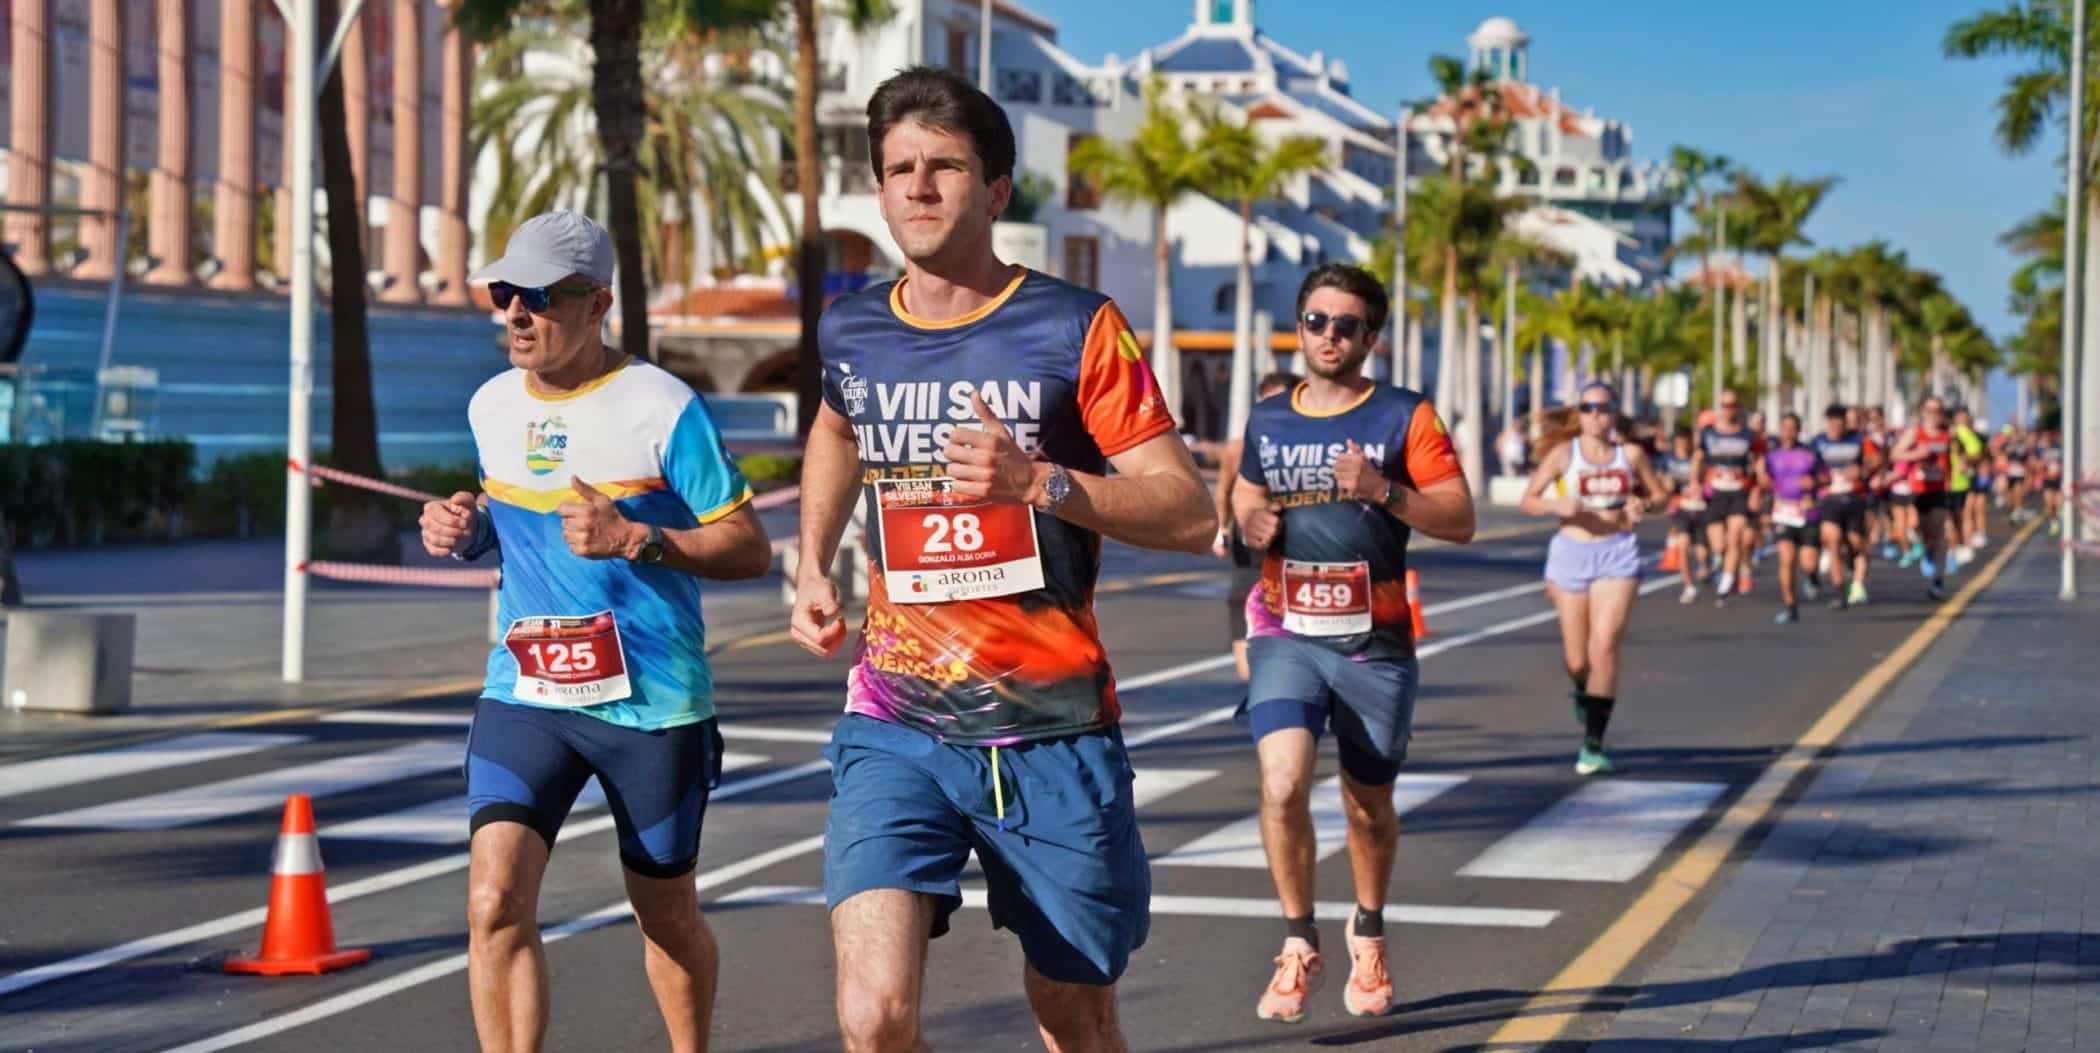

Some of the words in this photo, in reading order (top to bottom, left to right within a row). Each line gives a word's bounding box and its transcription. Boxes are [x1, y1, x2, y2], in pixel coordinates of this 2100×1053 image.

[876, 382, 941, 421] VIII
[852, 424, 1040, 463] ILVESE
[1281, 444, 1324, 467] VIII
[1326, 443, 1385, 467] SN
[922, 512, 984, 553] 28
[1296, 583, 1352, 608] 459
[528, 641, 597, 672] 125
